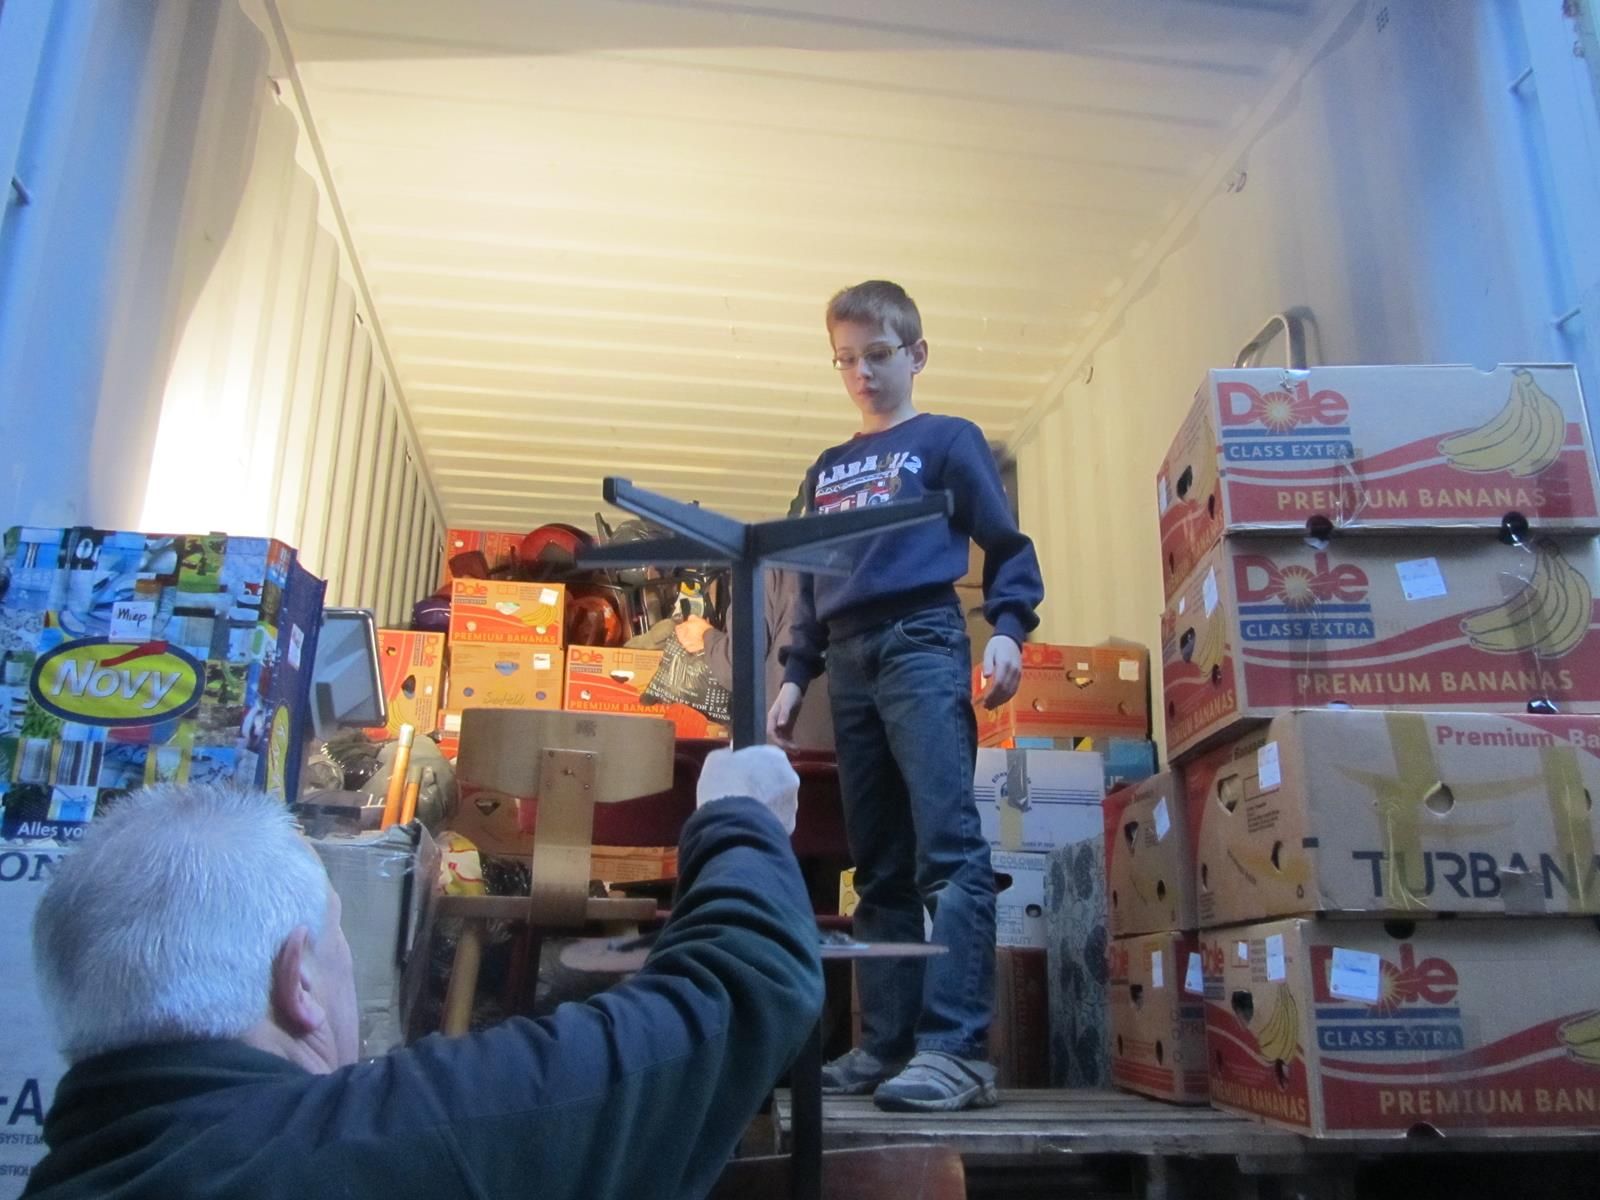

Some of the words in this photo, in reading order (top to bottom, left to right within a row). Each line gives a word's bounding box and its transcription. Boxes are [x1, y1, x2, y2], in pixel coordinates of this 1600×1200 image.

[1216, 380, 1349, 432] Dole
[1230, 446, 1285, 458] CLASS
[1291, 444, 1350, 457] EXTRA
[1277, 489, 1409, 511] PREMIUM
[1419, 487, 1547, 508] BANANAS
[1232, 552, 1369, 607] Dole
[455, 582, 488, 595] Dole
[453, 632, 504, 642] PREMIUM
[508, 634, 557, 643] BANANAS
[1246, 623, 1303, 637] CLASS
[1310, 622, 1370, 636] EXTRA
[571, 649, 604, 664] Dole
[51, 659, 183, 710] Novy
[1297, 672, 1431, 695] PREMIUM
[1441, 669, 1574, 692] BANANAS
[570, 702, 620, 711] PREMIUM
[623, 703, 669, 714] BANANA
[1436, 725, 1555, 748] Premium
[1569, 728, 1600, 749] Ba
[17, 822, 58, 836] Alles
[63, 827, 88, 838] vo
[1324, 1031, 1387, 1047] CLASS
[1395, 1030, 1460, 1046] EXTRA
[1379, 1089, 1524, 1115] PREMIUM
[1535, 1087, 1600, 1112] BAN
